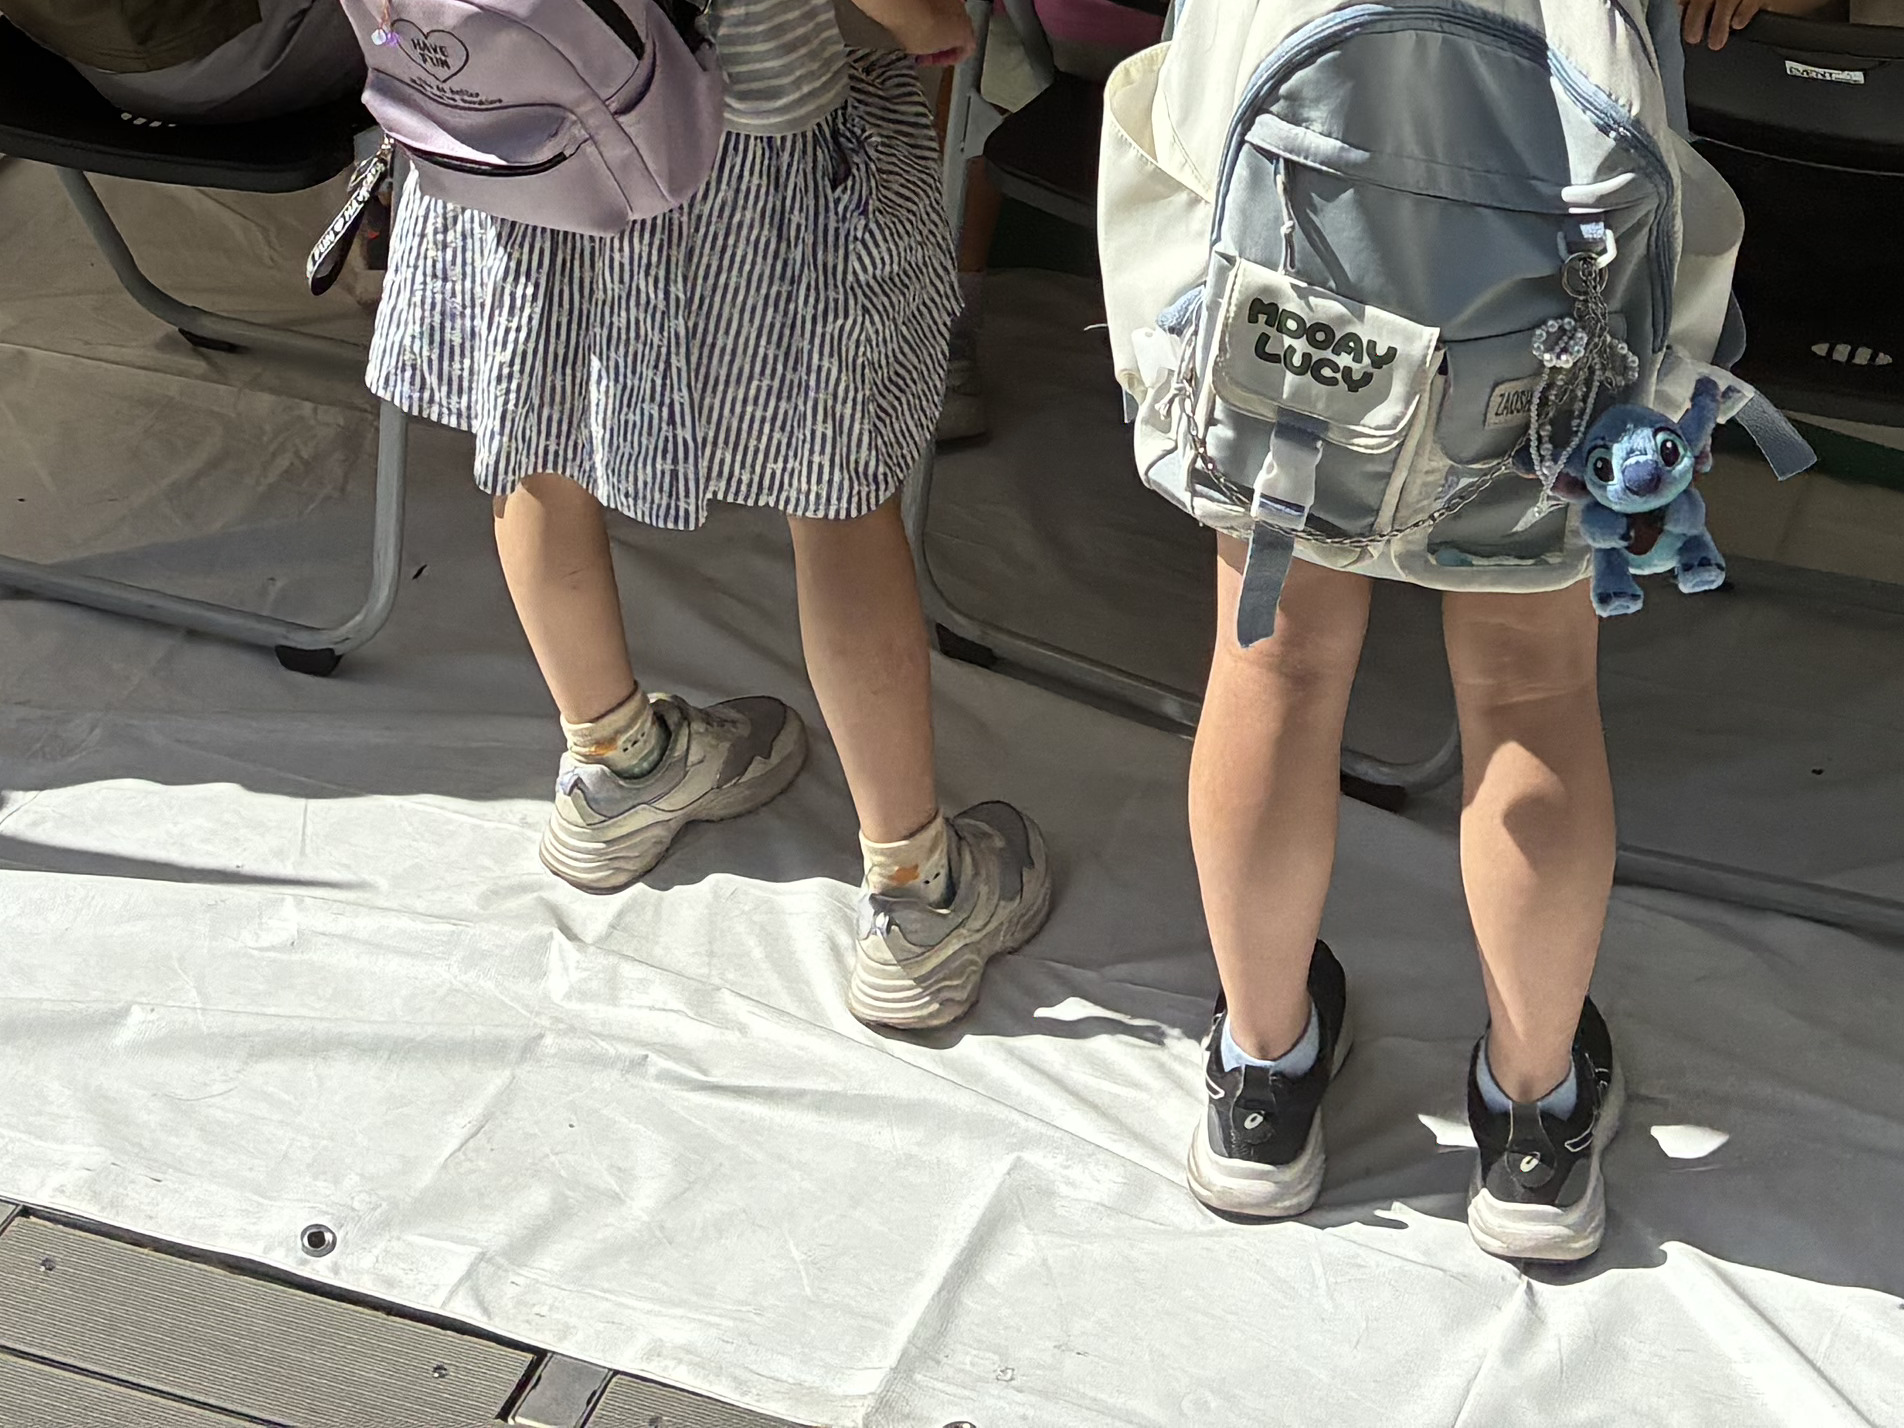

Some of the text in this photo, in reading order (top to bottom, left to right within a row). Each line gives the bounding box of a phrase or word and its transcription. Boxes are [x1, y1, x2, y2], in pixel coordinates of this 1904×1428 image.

[411, 38, 449, 58] HAVE
[419, 52, 451, 70] FUN
[1248, 297, 1397, 369] MDOAY
[1254, 331, 1374, 393] LUCY
